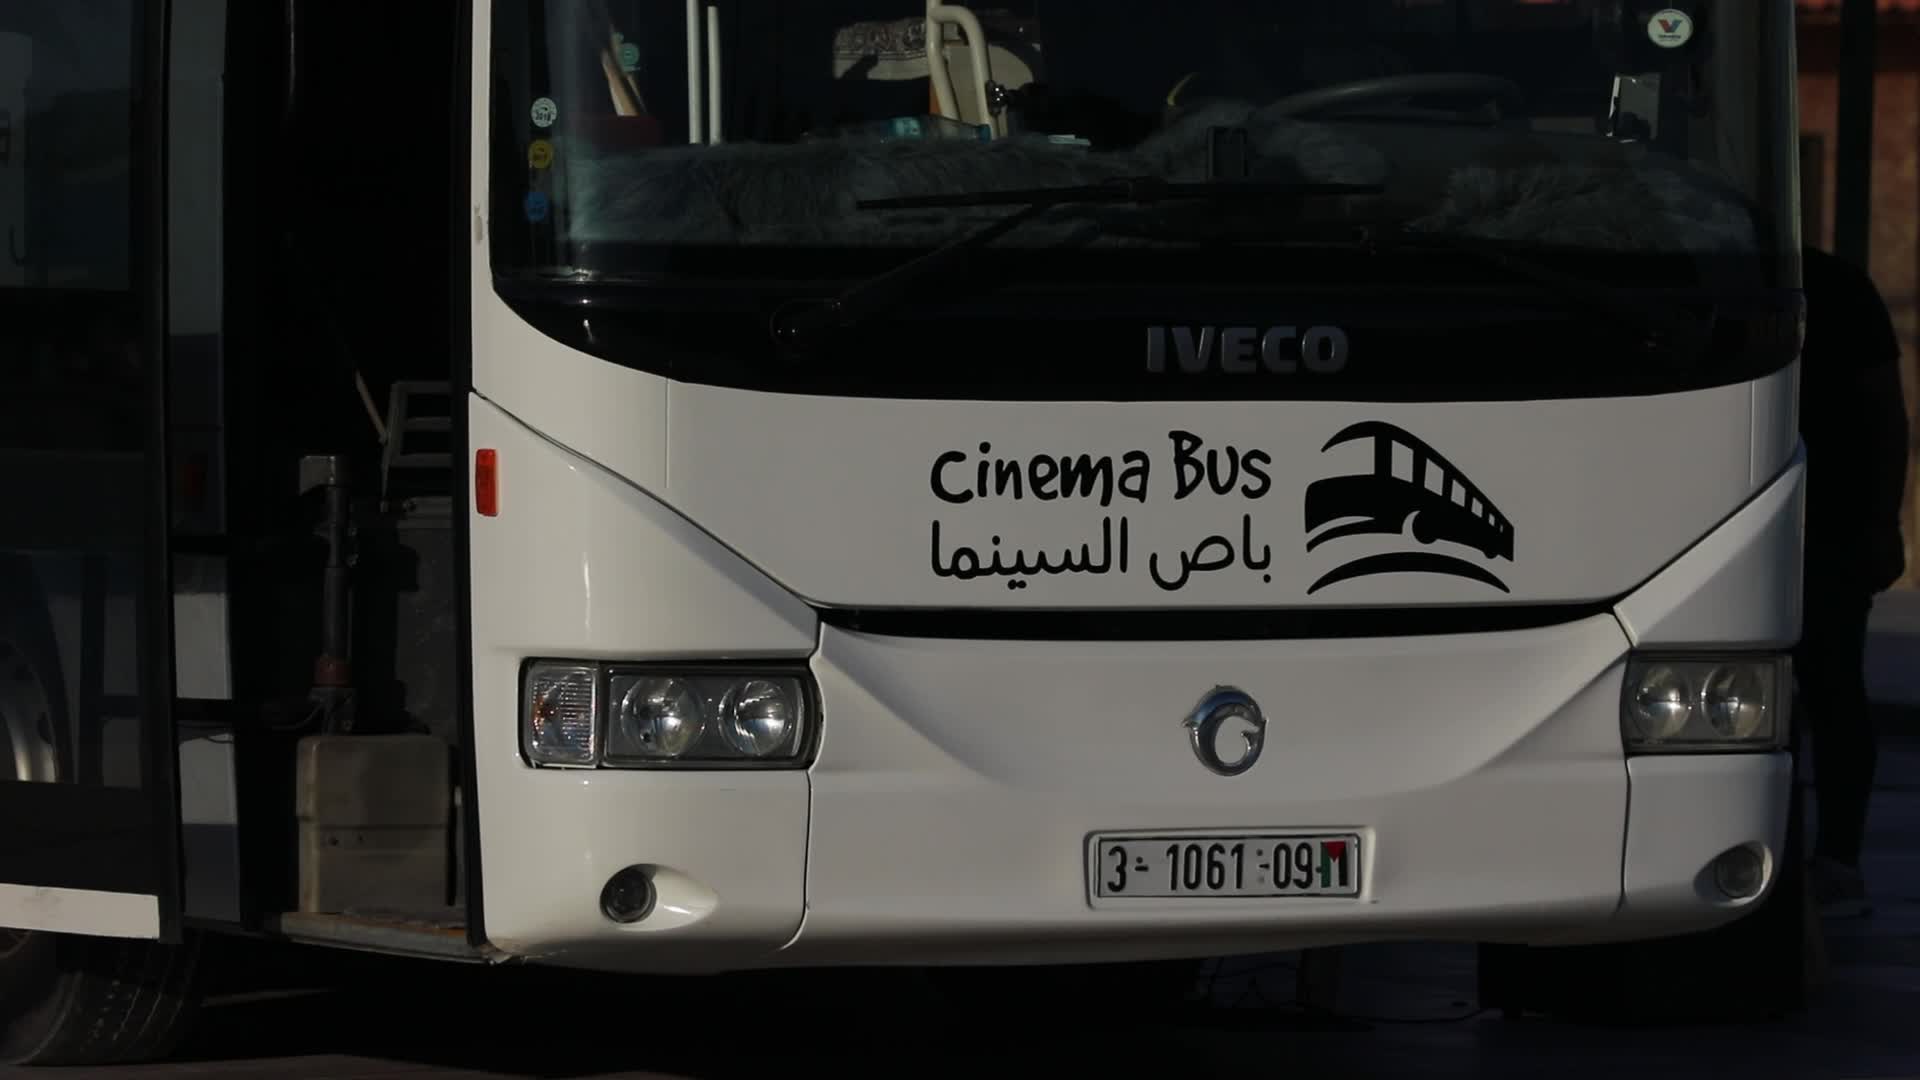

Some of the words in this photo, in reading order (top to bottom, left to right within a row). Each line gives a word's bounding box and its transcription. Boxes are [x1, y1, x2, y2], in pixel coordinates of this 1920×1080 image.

[1146, 324, 1350, 374] IVECO
[1169, 431, 1271, 499] Bus
[931, 517, 1128, 589] السينما
[1150, 515, 1271, 590] باص
[1166, 843, 1244, 891] 1061
